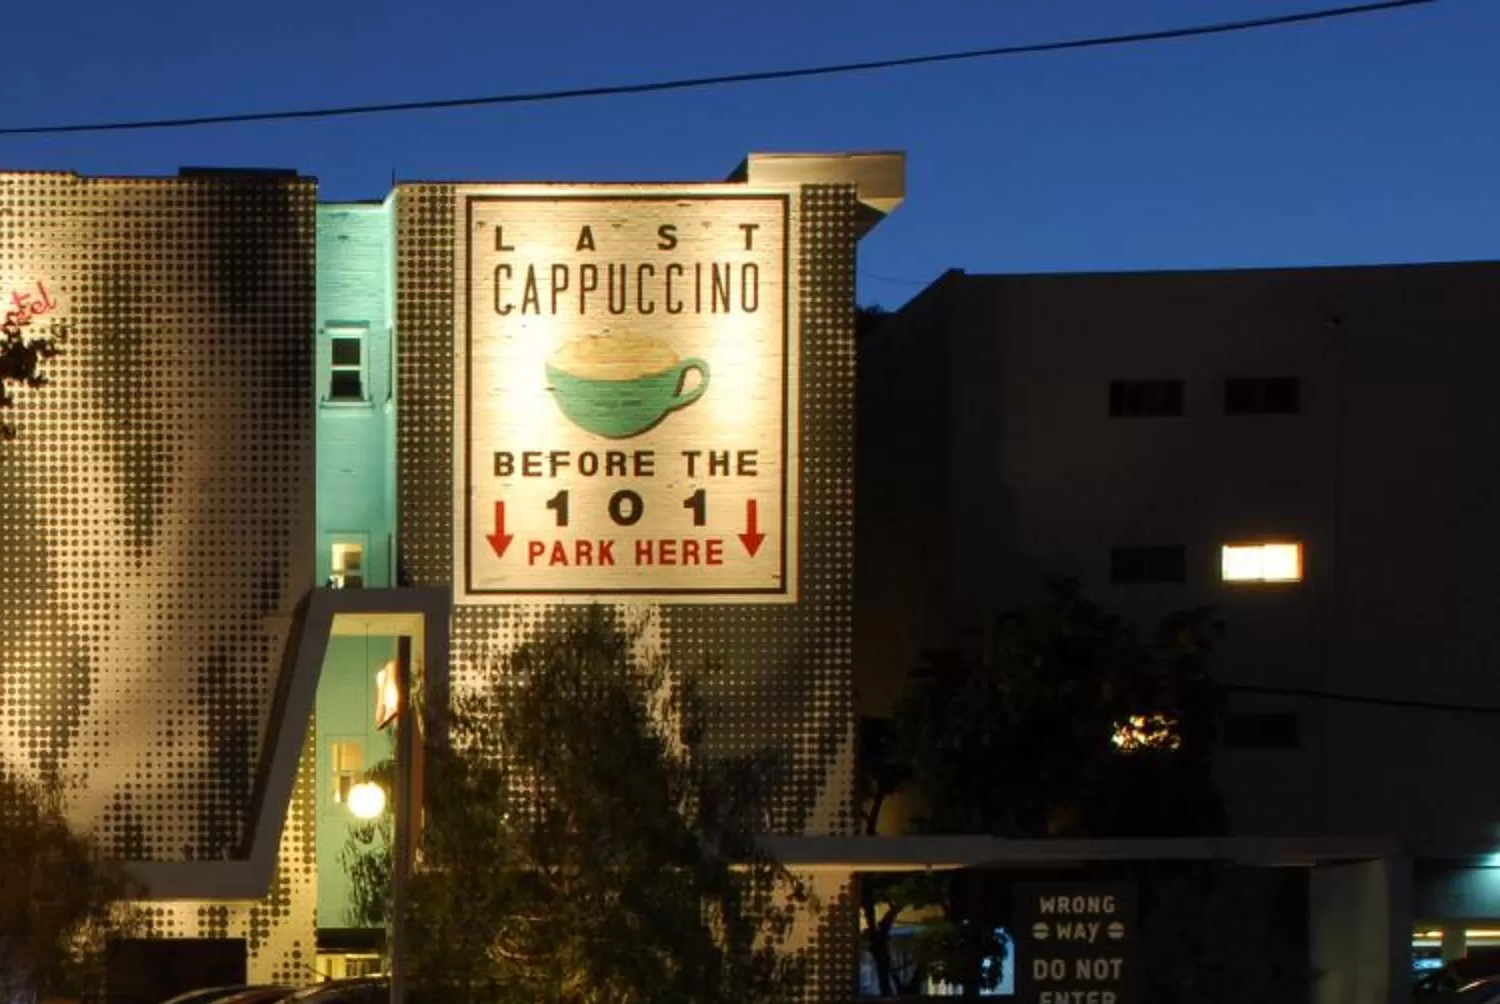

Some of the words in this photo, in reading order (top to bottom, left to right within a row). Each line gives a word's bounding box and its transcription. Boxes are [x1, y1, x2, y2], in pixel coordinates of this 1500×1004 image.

[494, 223, 760, 252] LAST
[493, 262, 760, 316] CAPPUCCINO
[493, 450, 656, 477] BEFORE
[681, 450, 759, 477] THE
[545, 488, 708, 528] 101
[528, 539, 616, 566] PARK
[635, 539, 724, 566] HERE
[1039, 895, 1117, 914] WRONG
[1032, 959, 1066, 981] DO
[1075, 958, 1124, 981] NOT
